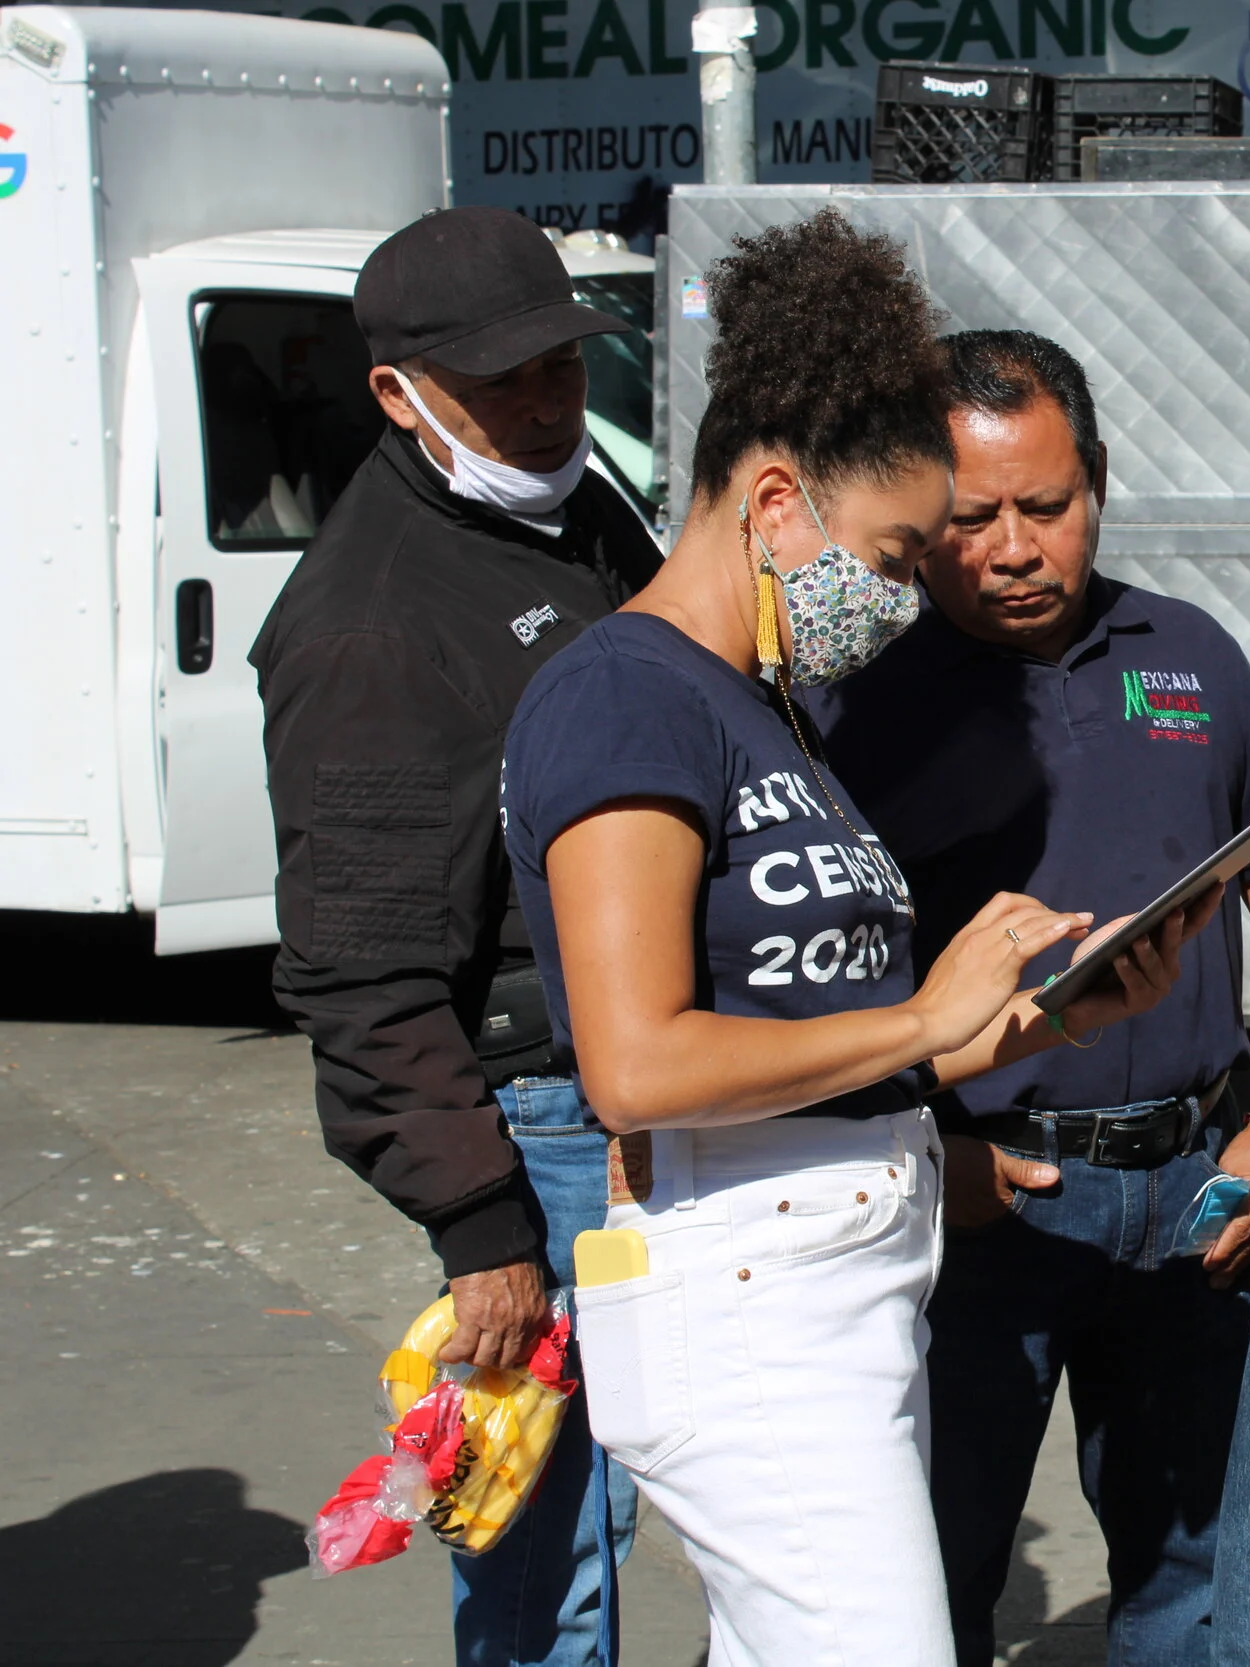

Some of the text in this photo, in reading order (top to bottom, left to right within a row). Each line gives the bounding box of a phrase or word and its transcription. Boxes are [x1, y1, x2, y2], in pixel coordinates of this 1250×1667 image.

[484, 123, 699, 175] DISTRIBUTO
[750, 843, 909, 906] CENSU
[748, 923, 889, 986] 2020
